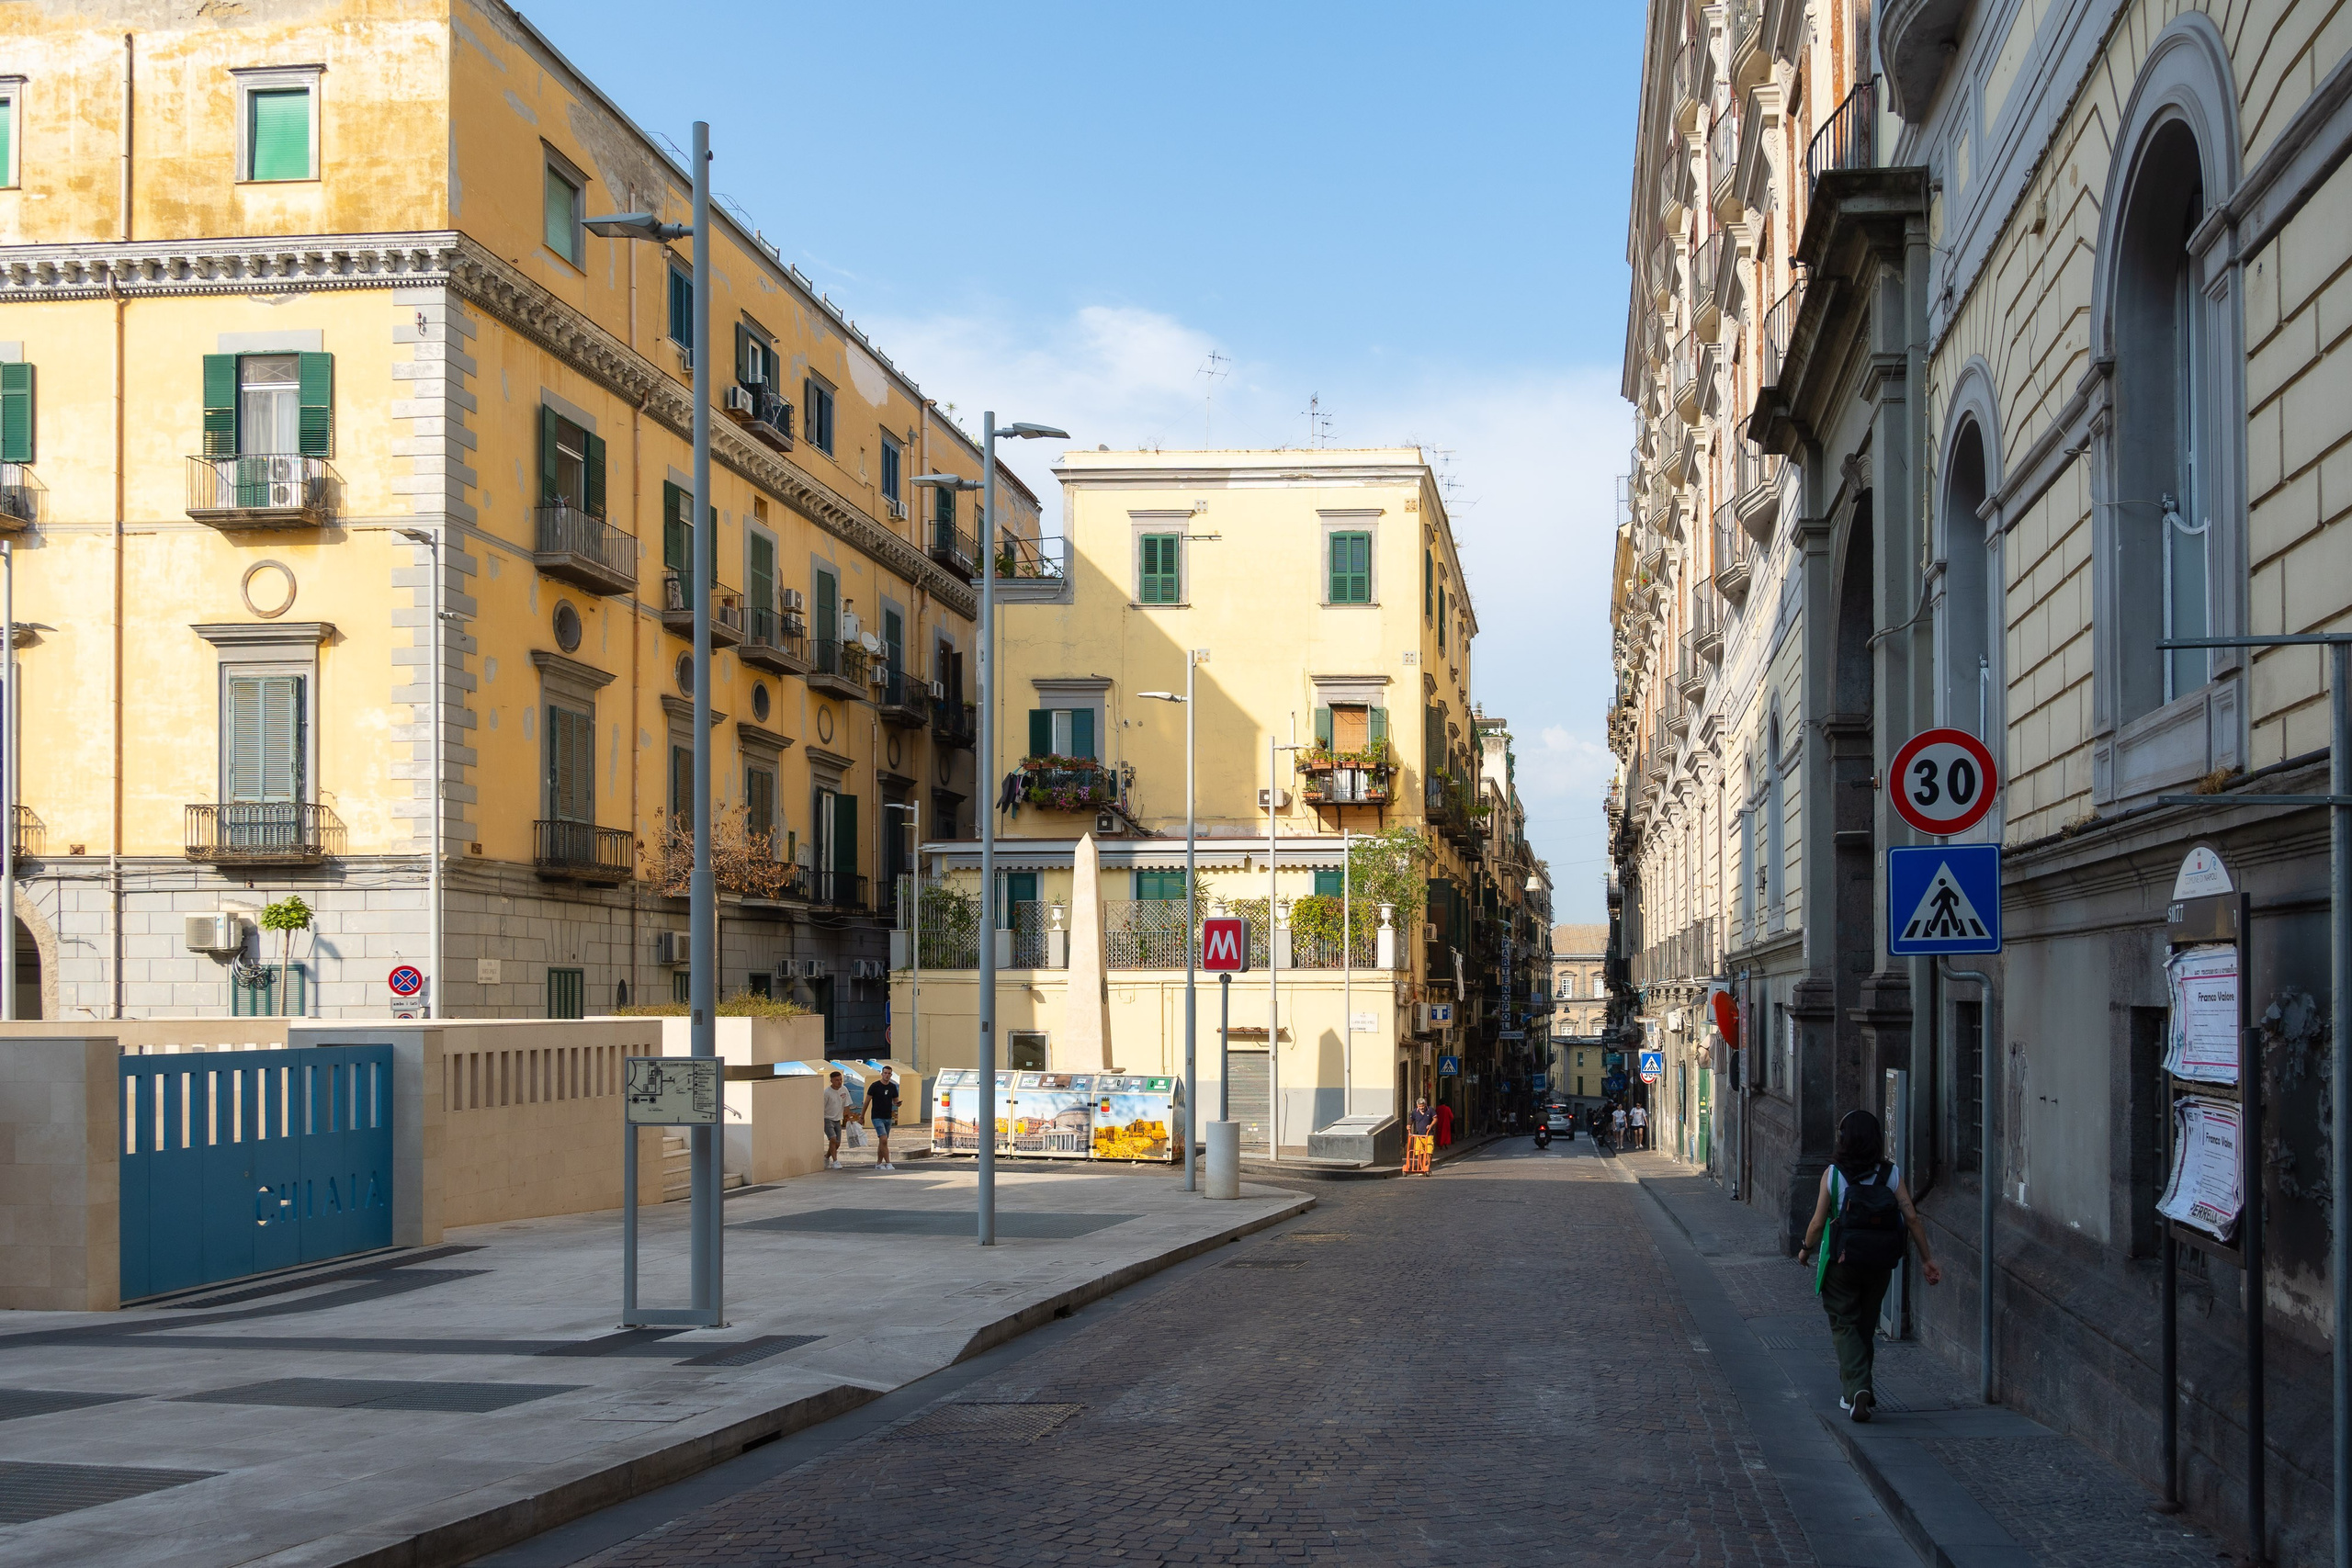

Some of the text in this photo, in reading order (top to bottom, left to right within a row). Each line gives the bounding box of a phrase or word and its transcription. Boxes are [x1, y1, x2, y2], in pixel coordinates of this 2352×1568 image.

[1913, 758, 1976, 806] 30
[1206, 930, 1238, 960] M
[2198, 991, 2234, 1002] Franco Valore
[2206, 1132, 2221, 1145] Franco
[255, 1169, 384, 1226] CHIAIA
